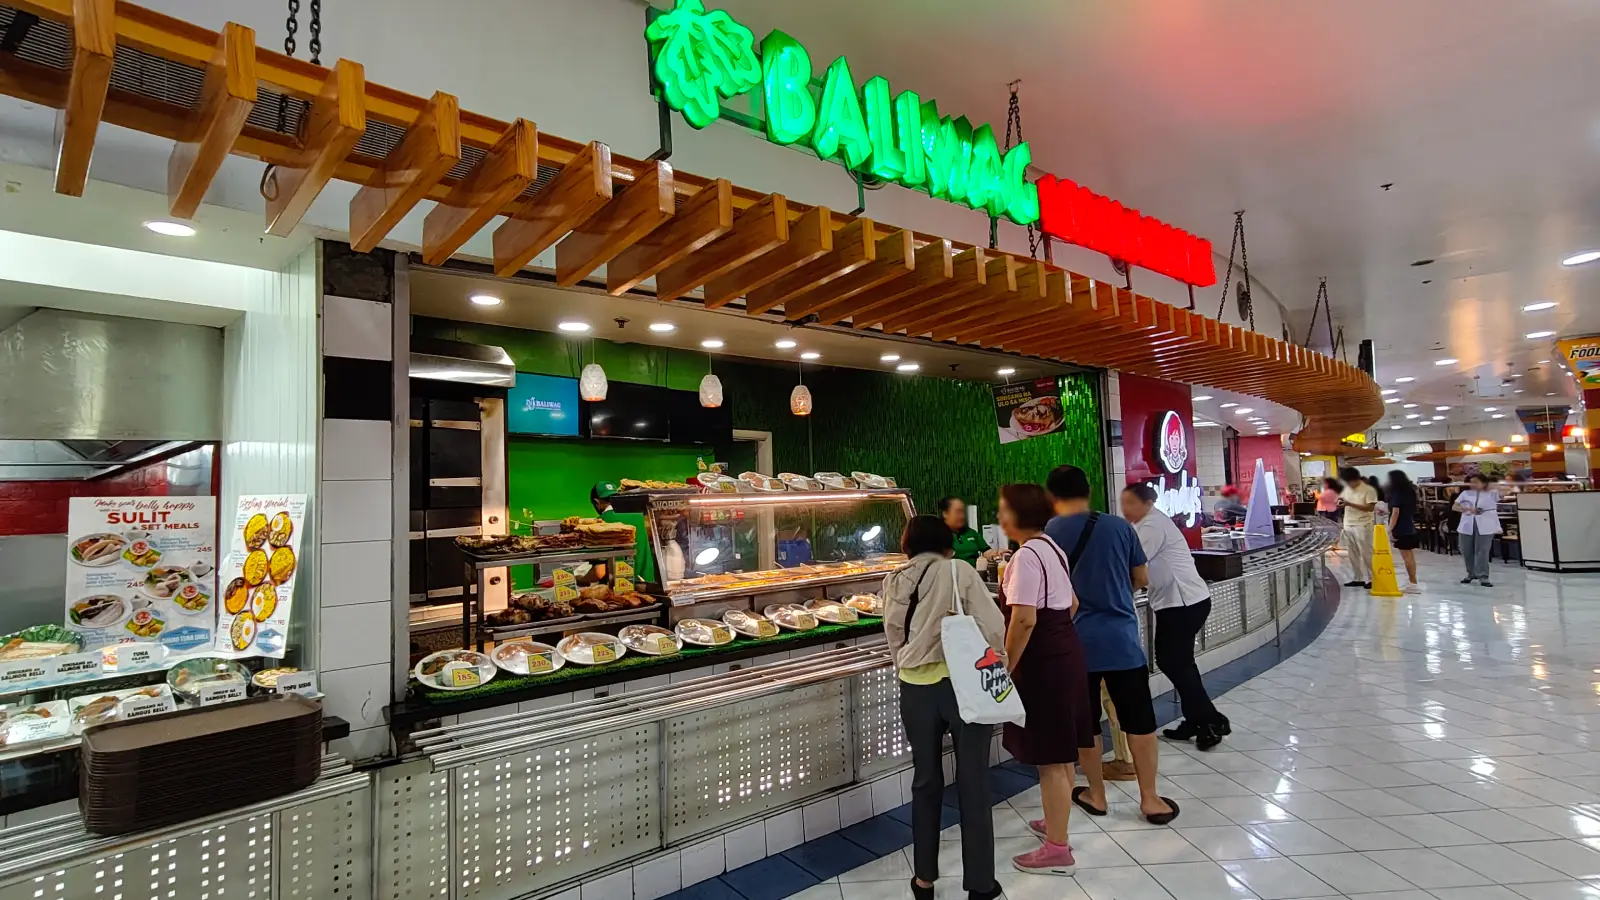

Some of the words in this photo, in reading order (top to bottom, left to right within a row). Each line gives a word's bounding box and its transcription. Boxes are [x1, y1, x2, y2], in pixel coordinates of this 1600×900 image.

[762, 29, 1040, 226] BALIWAG
[135, 499, 160, 510] belly
[163, 501, 195, 511] happy
[107, 511, 171, 524] SULIT
[164, 522, 200, 530] MEALS
[531, 660, 547, 668] 230
[57, 665, 81, 673] SALMON
[457, 674, 472, 682] 185
